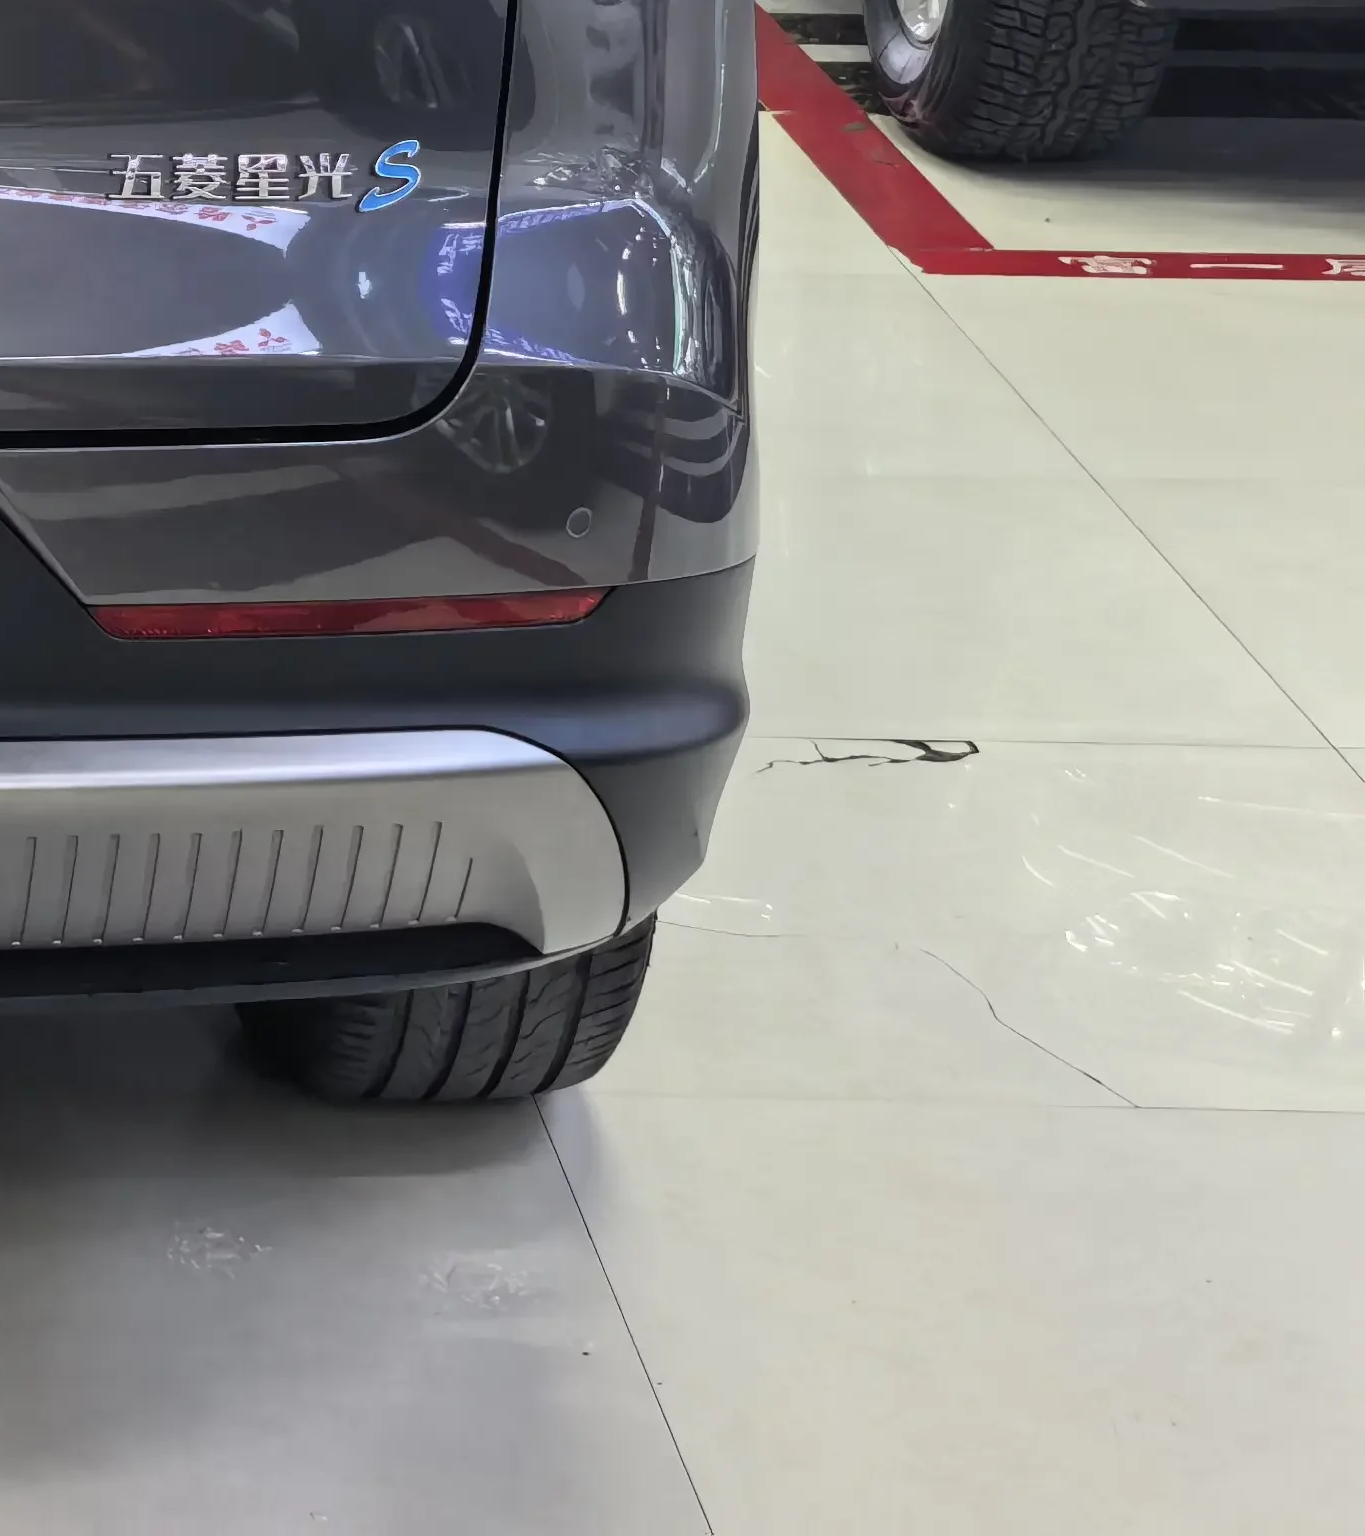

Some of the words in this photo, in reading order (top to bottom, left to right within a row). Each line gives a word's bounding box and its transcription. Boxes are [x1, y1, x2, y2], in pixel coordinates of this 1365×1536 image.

[108, 152, 353, 200] 五菱星光
[358, 139, 422, 213] S
